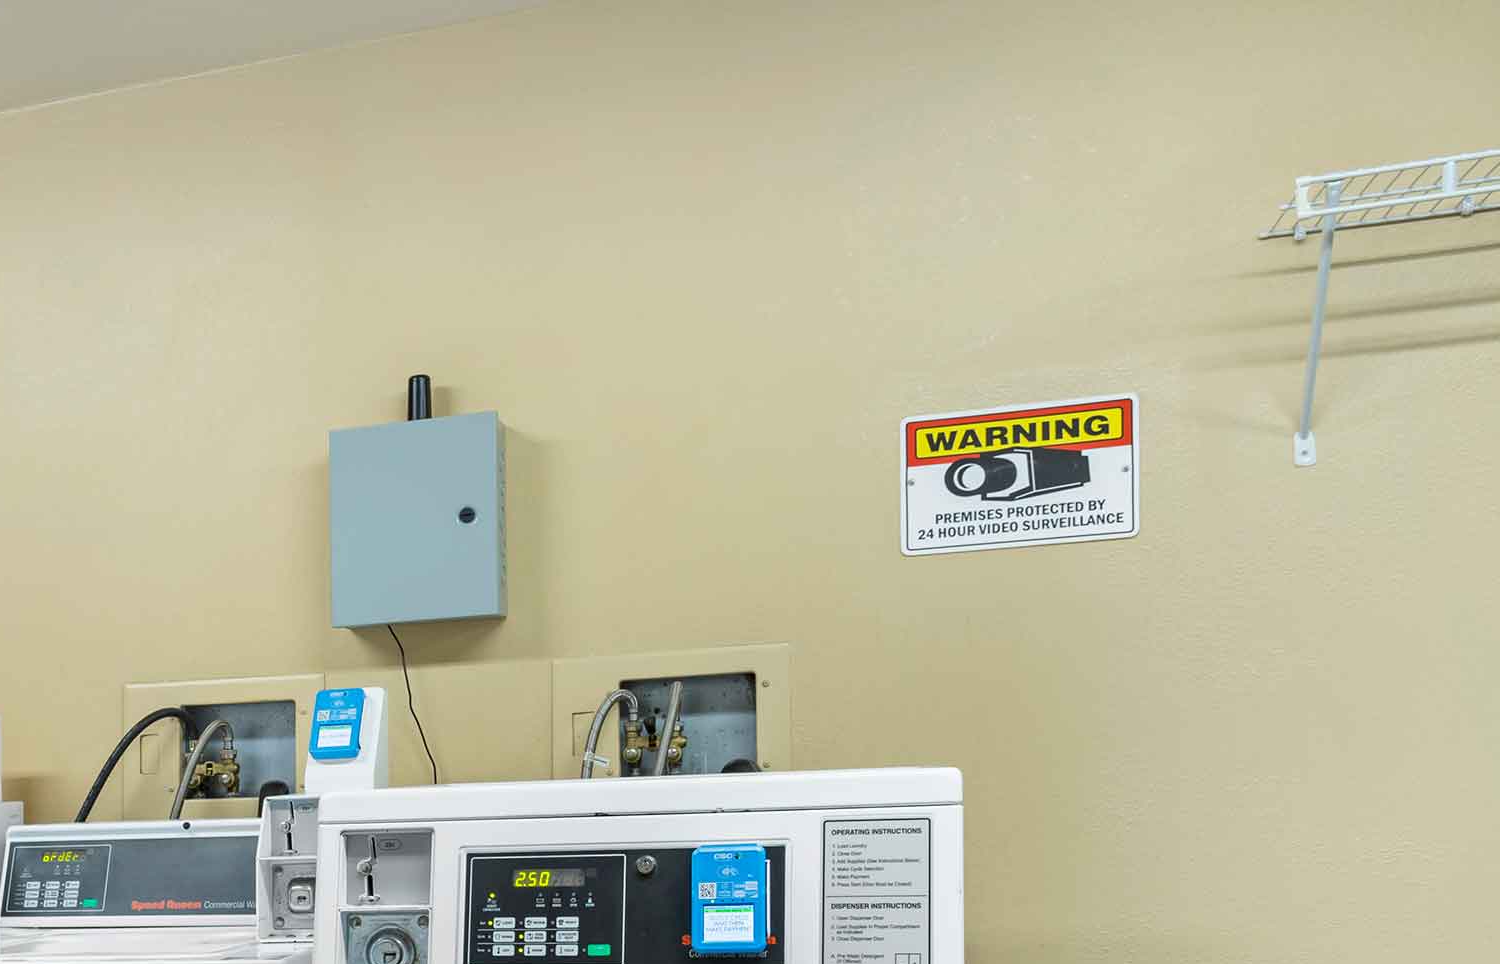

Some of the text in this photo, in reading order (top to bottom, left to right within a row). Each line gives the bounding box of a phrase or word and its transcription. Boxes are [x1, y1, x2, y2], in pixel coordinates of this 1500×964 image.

[925, 415, 1110, 452] WARNING
[935, 499, 1106, 524] PREMISES PROTECTED BY
[918, 512, 1124, 540] 24 HOUR VIDEO SURVEILLANCE
[831, 827, 922, 836] OPERATING INSTRUCTIONS
[515, 871, 550, 887] 2.50
[203, 900, 245, 909] Commercial
